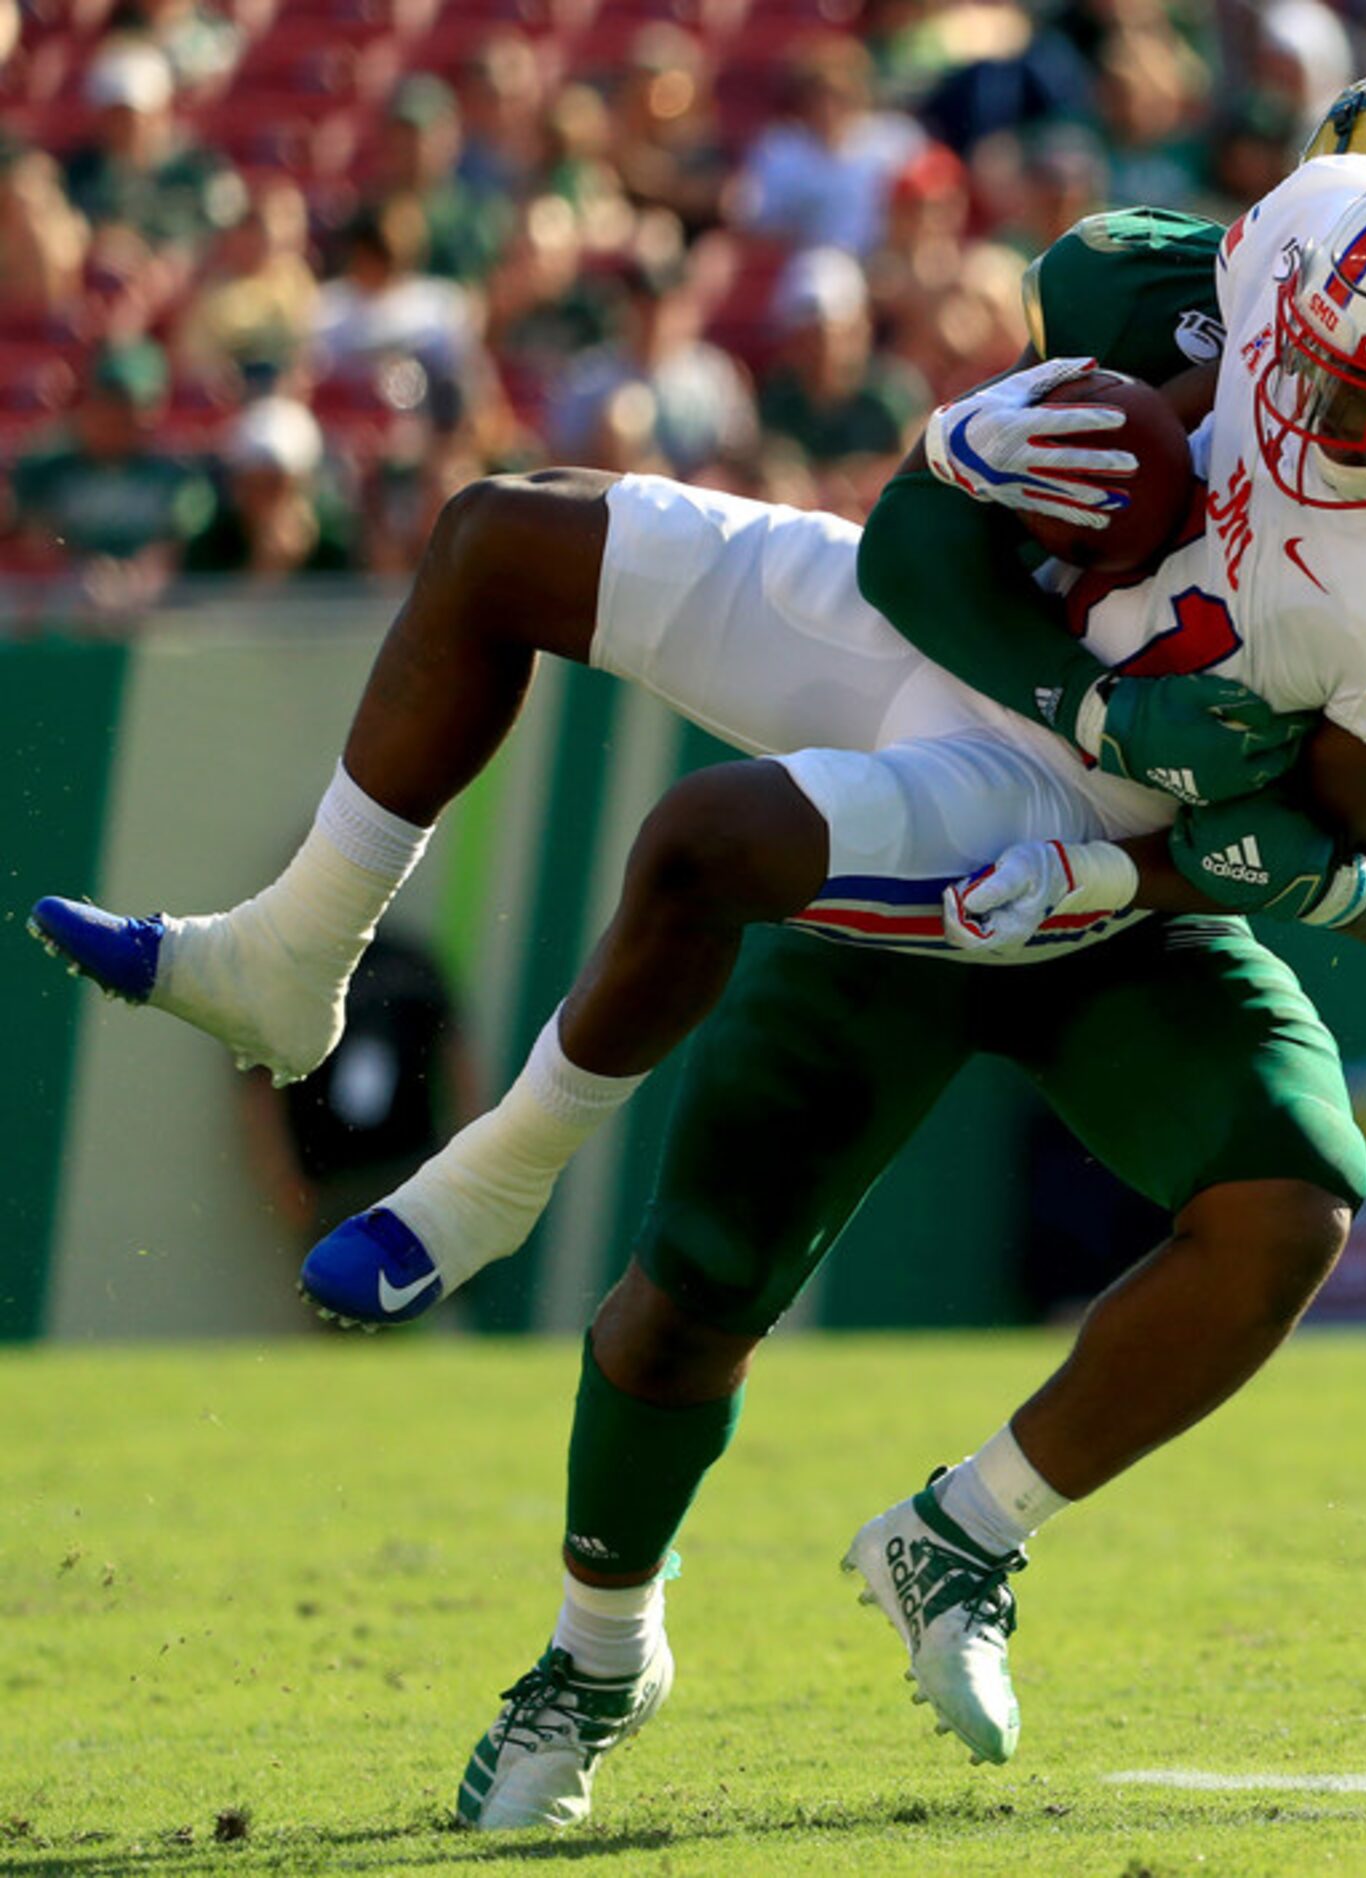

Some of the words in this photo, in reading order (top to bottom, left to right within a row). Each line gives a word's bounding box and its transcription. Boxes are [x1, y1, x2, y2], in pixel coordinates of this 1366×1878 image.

[1309, 293, 1340, 333] SMU
[1206, 456, 1253, 593] SMU
[1202, 855, 1269, 885] adidas
[885, 1536, 922, 1654] adidas
